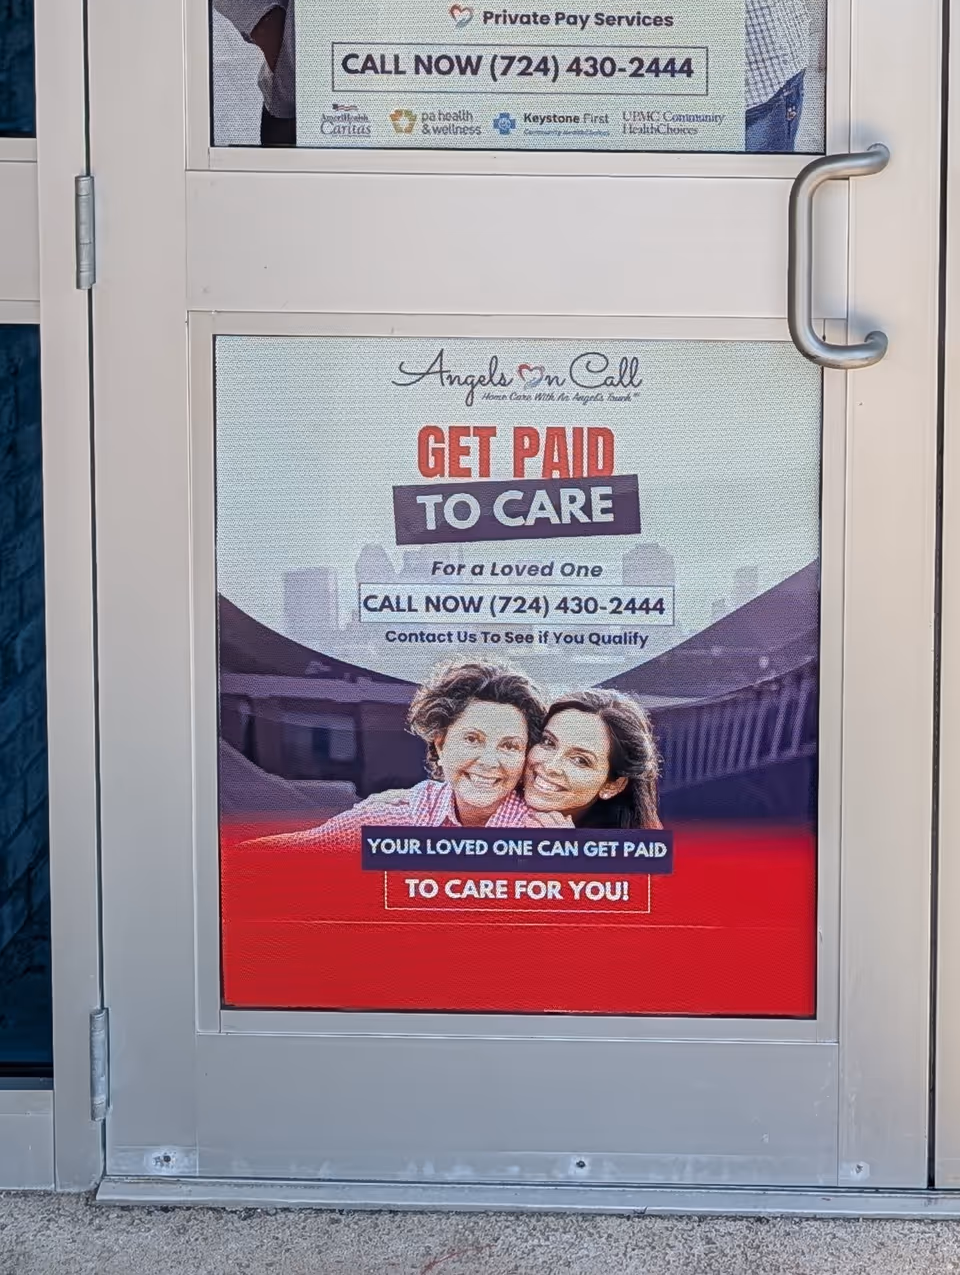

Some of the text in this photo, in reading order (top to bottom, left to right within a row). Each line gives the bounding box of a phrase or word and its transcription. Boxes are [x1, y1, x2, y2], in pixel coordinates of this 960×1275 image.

[483, 10, 673, 30] Private Pay Services
[342, 53, 694, 83] CALL NOW (724) 430-2444
[438, 110, 473, 122] health
[524, 113, 609, 125] Keystone First
[392, 349, 513, 406] Angels
[570, 352, 642, 388] Call
[417, 425, 614, 479] GET PAID
[417, 486, 614, 531] TO CARE
[432, 561, 603, 578] For a Loved One
[363, 595, 665, 618] CALL NOW (724) 430-2444
[385, 630, 649, 648] Contact Us To See if You Qualify
[367, 838, 668, 858] YOUR LOVED ONE CAN GET PAID
[405, 879, 629, 901] TO CARE FOR YOU!
